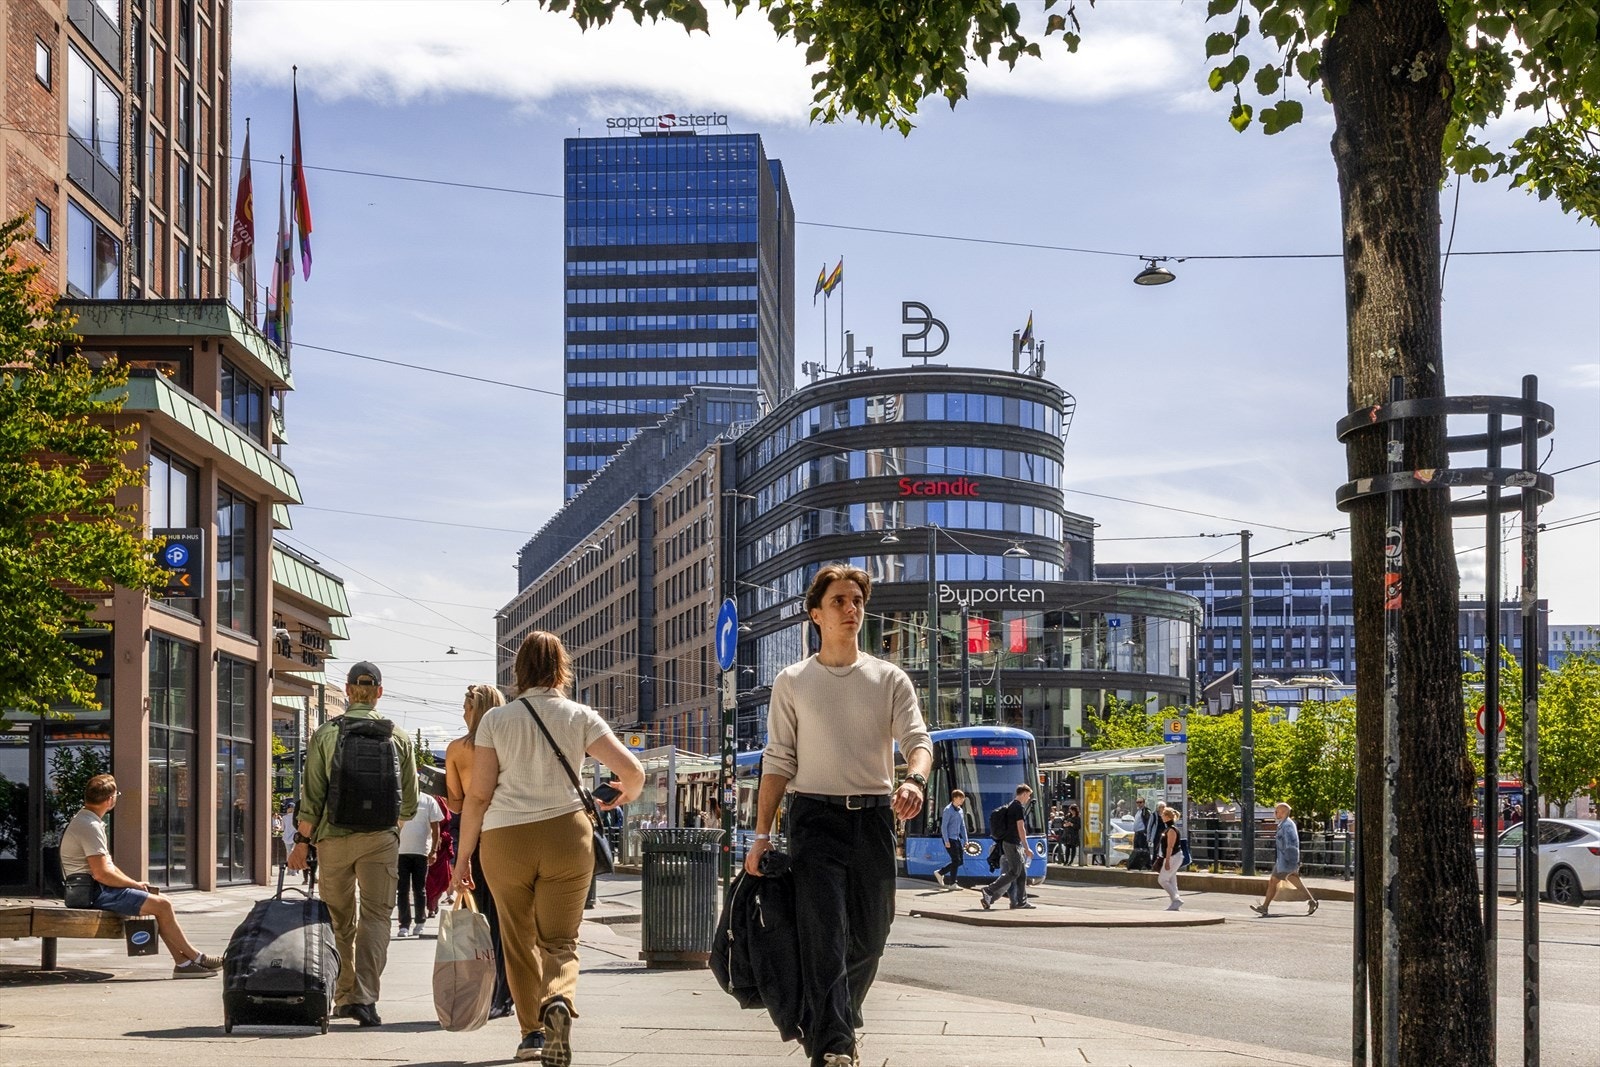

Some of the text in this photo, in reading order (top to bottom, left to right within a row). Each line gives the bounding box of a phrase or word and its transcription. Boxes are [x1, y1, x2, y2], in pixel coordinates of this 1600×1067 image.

[606, 112, 728, 130] sopra steria
[899, 477, 980, 496] Scandic
[939, 584, 1045, 607] Byporten
[1173, 722, 1179, 731] E
